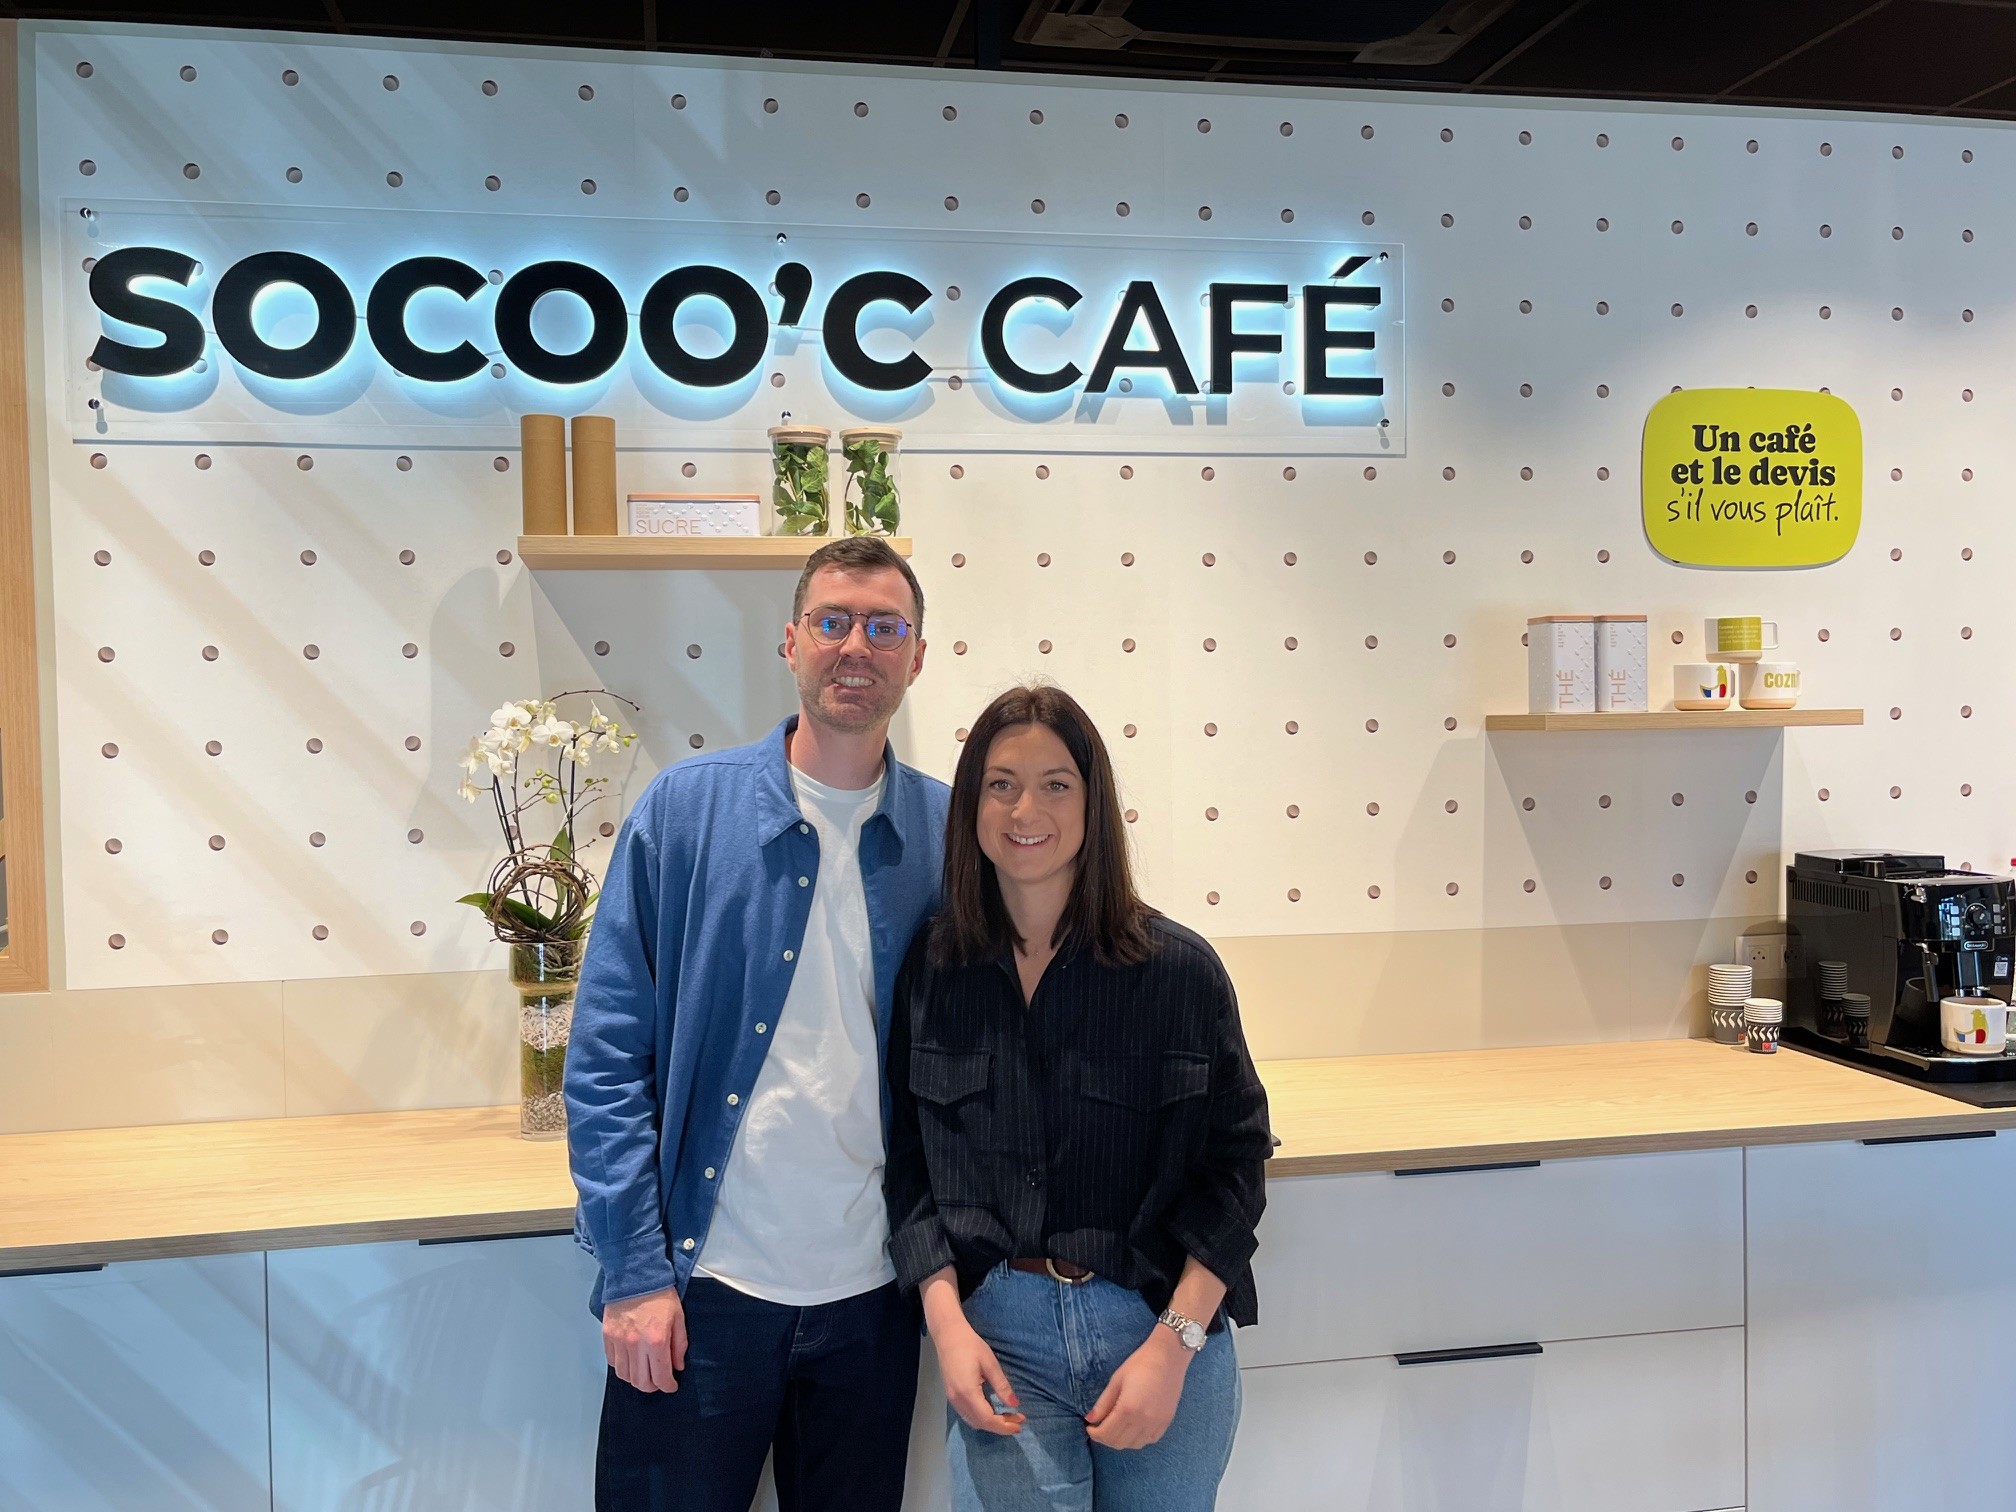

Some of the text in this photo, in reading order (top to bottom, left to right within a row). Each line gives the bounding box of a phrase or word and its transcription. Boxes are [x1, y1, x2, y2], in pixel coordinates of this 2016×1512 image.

[88, 246, 1385, 396] SOCOO'C CAFÉ
[1692, 423, 1816, 453] Un café
[1671, 456, 1836, 486] et le devis
[636, 519, 701, 535] SUCRE
[1667, 487, 1839, 536] s'il vous plaît.
[1556, 669, 1574, 709] THÉ
[1608, 669, 1626, 708] THÉ
